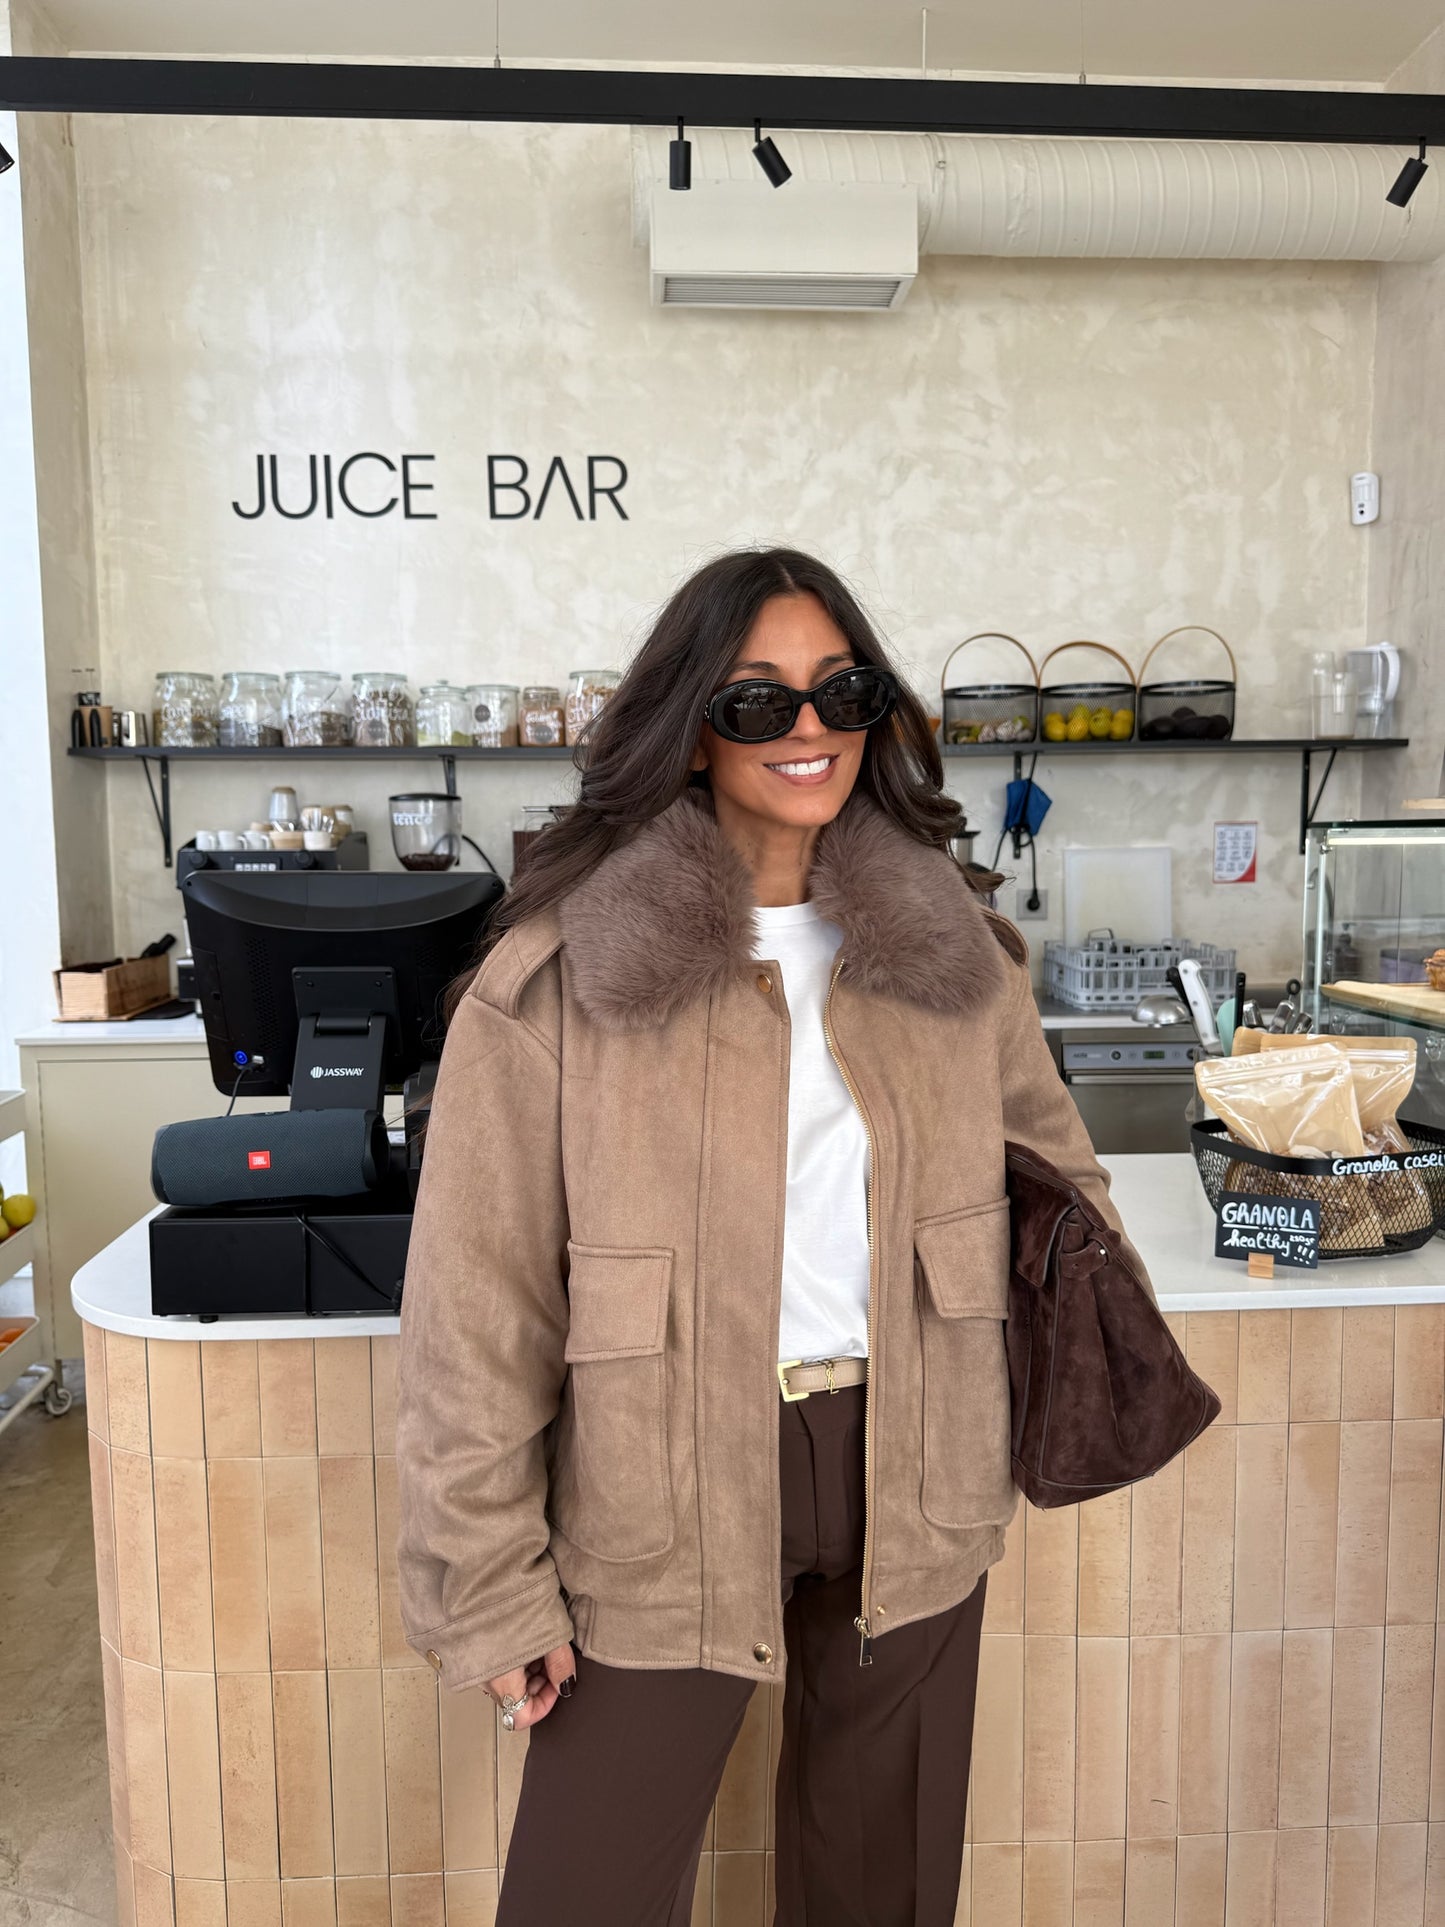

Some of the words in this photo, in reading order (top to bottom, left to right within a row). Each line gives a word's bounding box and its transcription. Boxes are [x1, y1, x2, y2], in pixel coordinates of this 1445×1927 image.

[232, 452, 437, 519] JUICE
[487, 455, 629, 520] BAR
[324, 1068, 364, 1077] JASSWAY
[252, 1156, 267, 1166] JBL
[1332, 1155, 1399, 1175] Granola
[1404, 1150, 1445, 1169] casei
[1223, 1229, 1290, 1257] healthy
